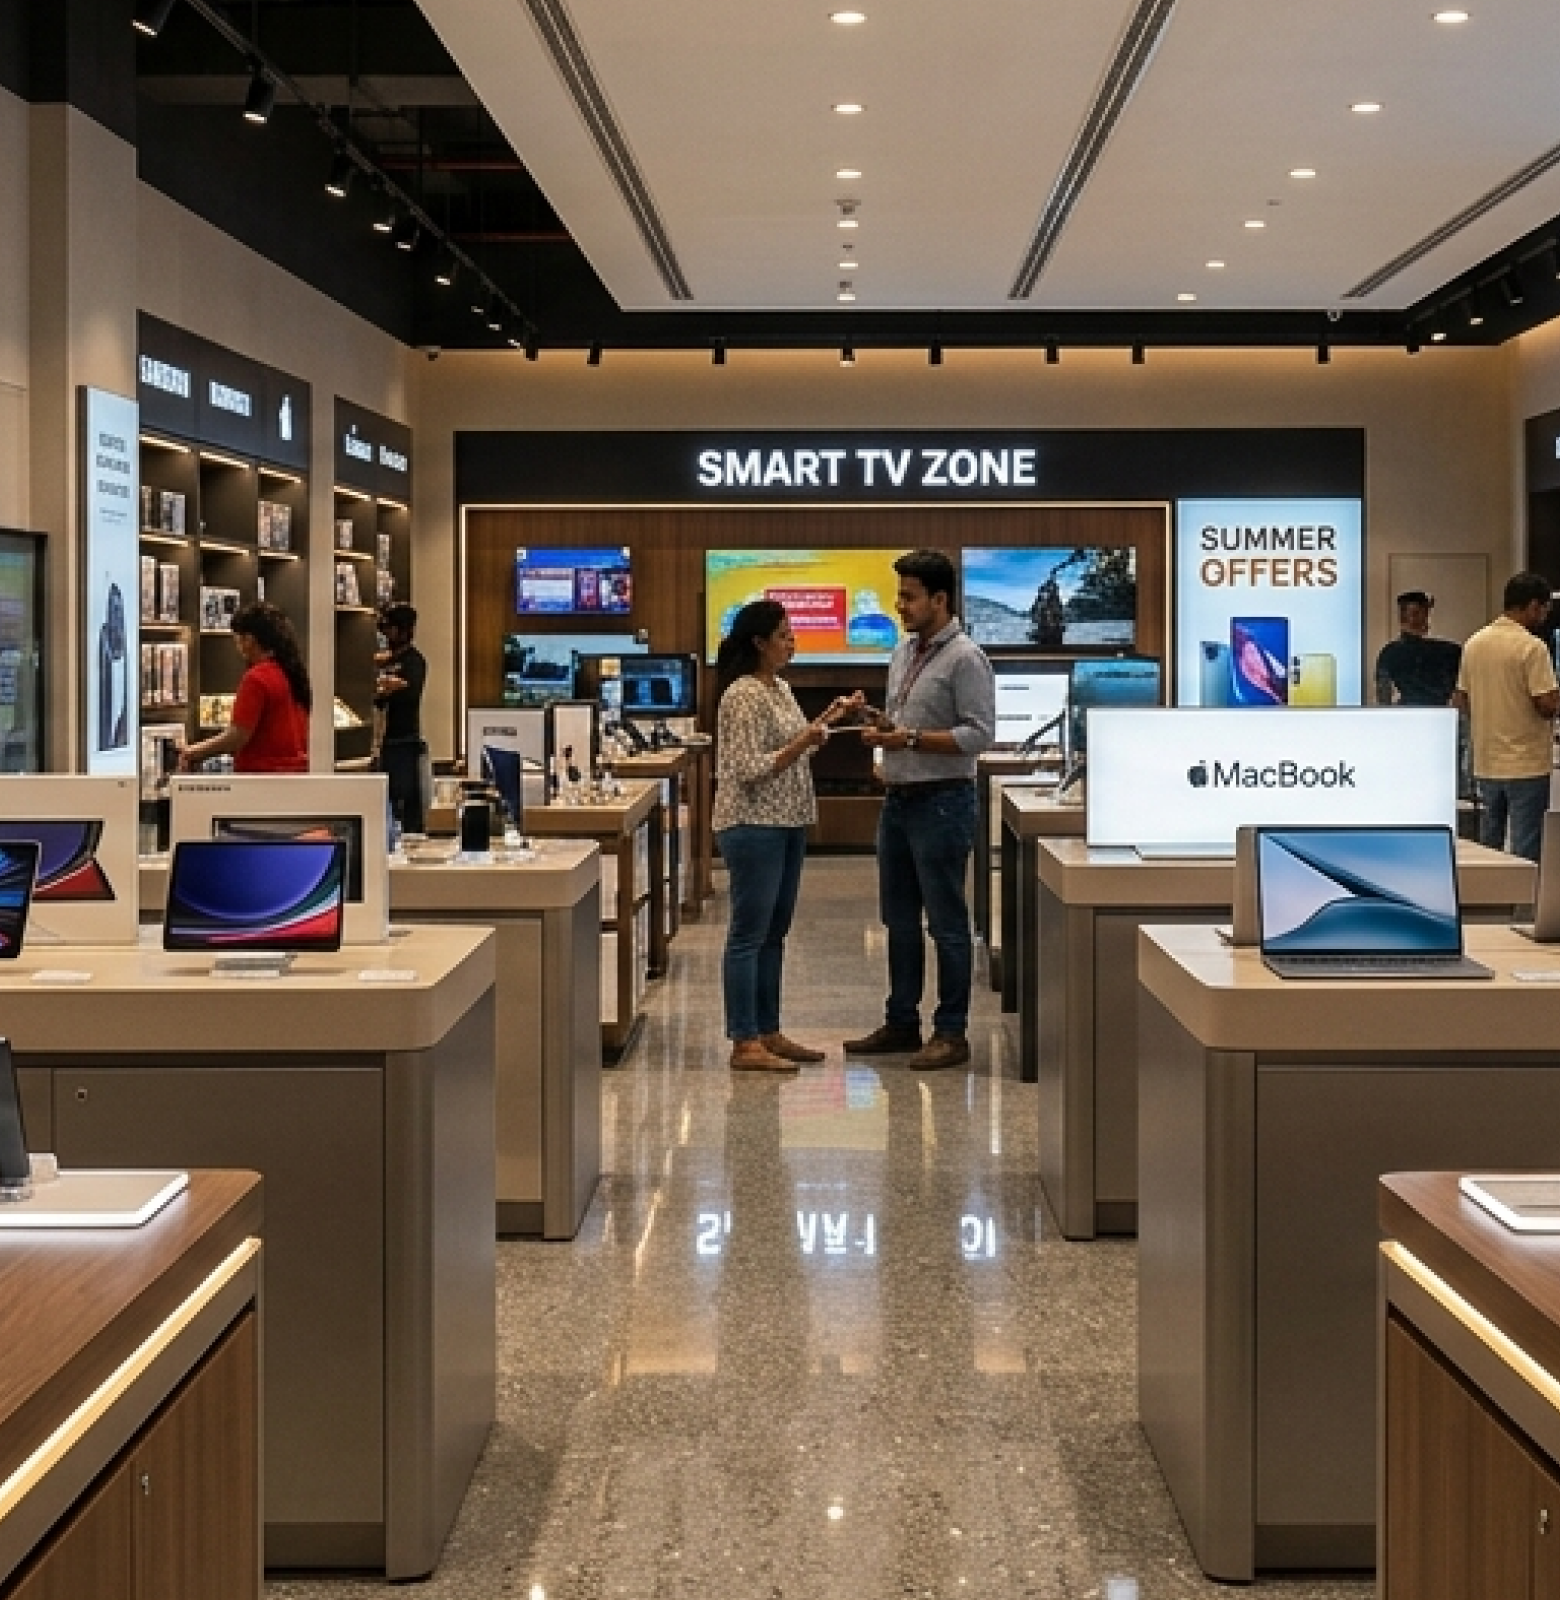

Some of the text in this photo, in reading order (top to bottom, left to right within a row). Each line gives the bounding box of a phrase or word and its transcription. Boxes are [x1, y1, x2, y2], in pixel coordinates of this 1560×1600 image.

[697, 448, 1037, 487] SMART TV ZONE
[1200, 525, 1337, 552] SUMMER
[1200, 557, 1338, 588] OFFERS
[1213, 759, 1356, 789] MacBook
